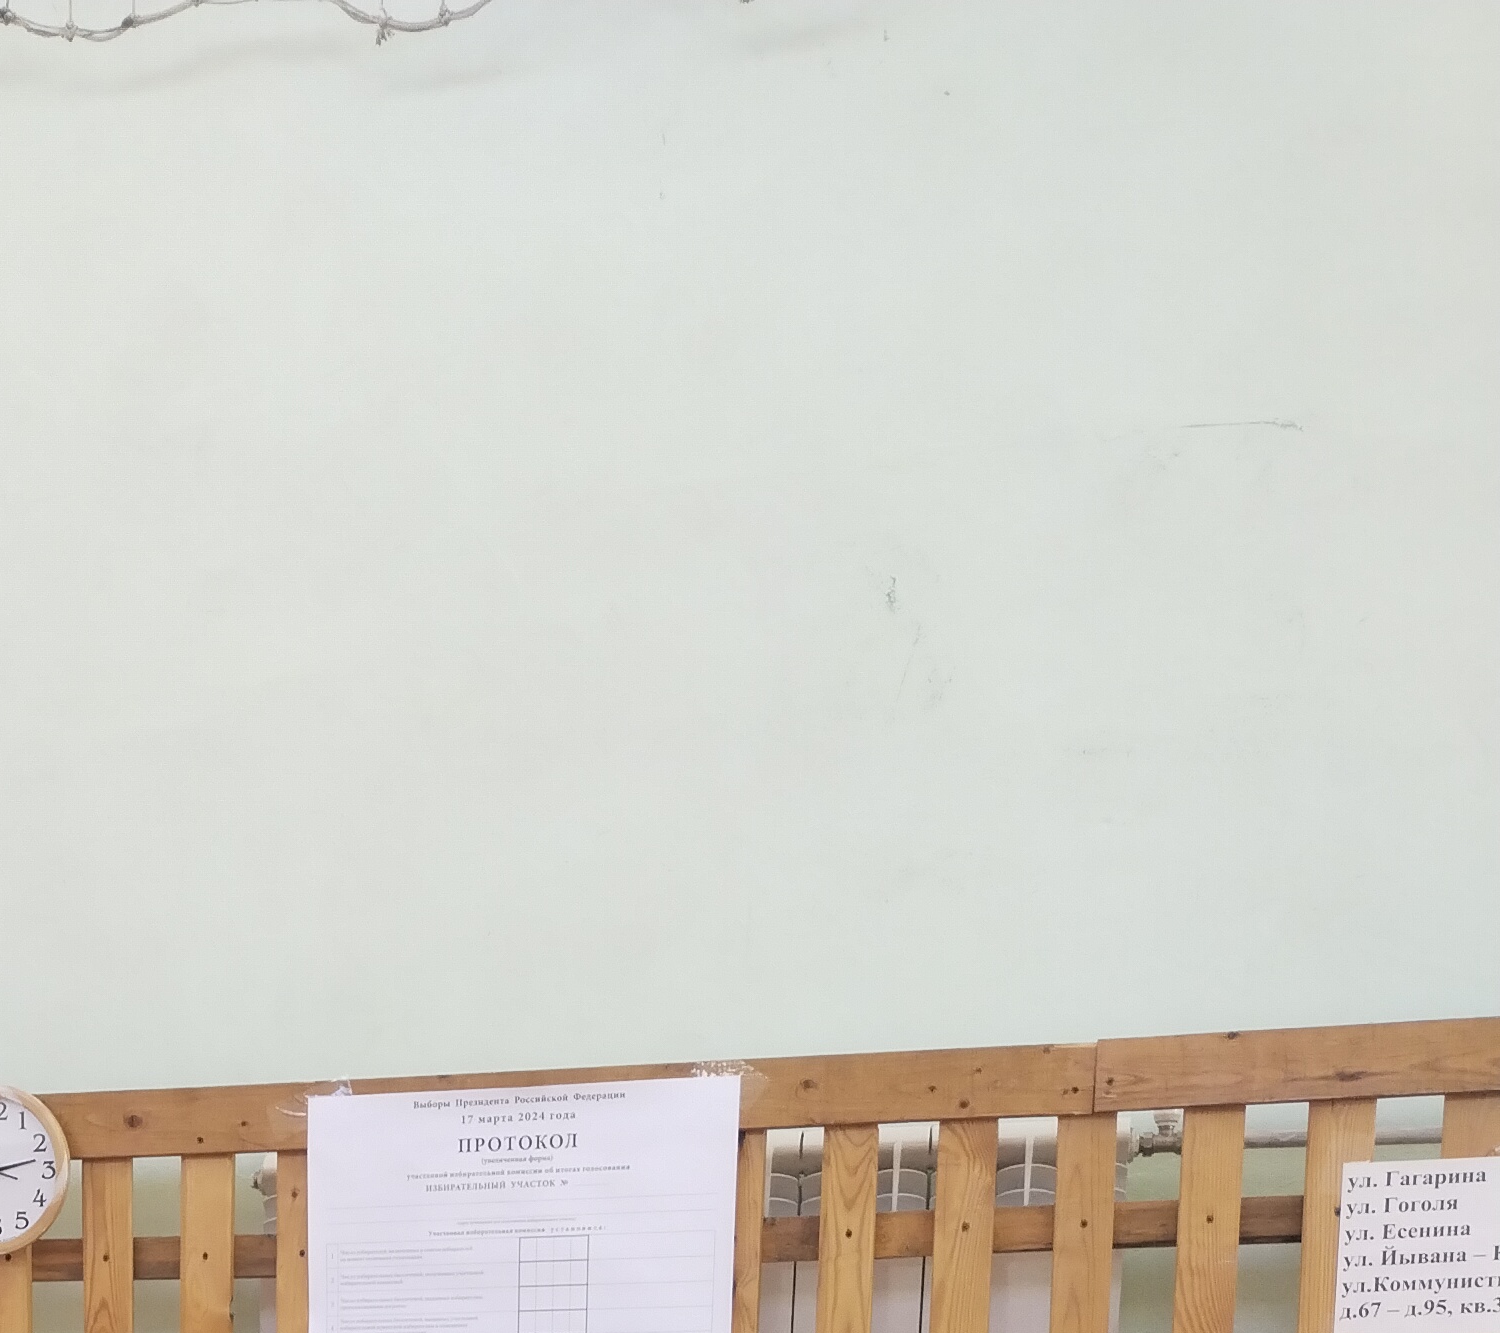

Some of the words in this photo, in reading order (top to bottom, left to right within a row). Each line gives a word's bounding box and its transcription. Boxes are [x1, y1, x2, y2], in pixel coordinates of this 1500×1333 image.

[413, 1099, 451, 1110] Выборы
[455, 1097, 510, 1109] Президента
[514, 1093, 569, 1105] Российской
[573, 1091, 626, 1102] Федерации
[19, 1111, 27, 1130] 1
[460, 1115, 474, 1124] 17
[478, 1114, 513, 1125] марта
[518, 1112, 545, 1122] 2024
[549, 1111, 576, 1121] года
[33, 1134, 48, 1153] 2
[457, 1133, 579, 1153] ПРОТОКОЛ
[41, 1160, 56, 1180] 3
[425, 1180, 507, 1193] ИЗБИРАТЕЛЬНЫЙ
[510, 1179, 556, 1189] УЧАСТОК
[1347, 1176, 1378, 1193] ул.
[1385, 1170, 1487, 1189] Гагарина
[33, 1189, 47, 1207] 4
[1345, 1202, 1376, 1219] ул.
[1383, 1196, 1458, 1213] Гоголя
[15, 1211, 29, 1230] 5
[1344, 1229, 1375, 1246] ул.
[1382, 1223, 1471, 1240] Есенина
[1342, 1255, 1373, 1272] ул.
[1380, 1245, 1467, 1266] Йывана
[1339, 1301, 1382, 1320] д.67
[1404, 1299, 1454, 1317] д.95,
